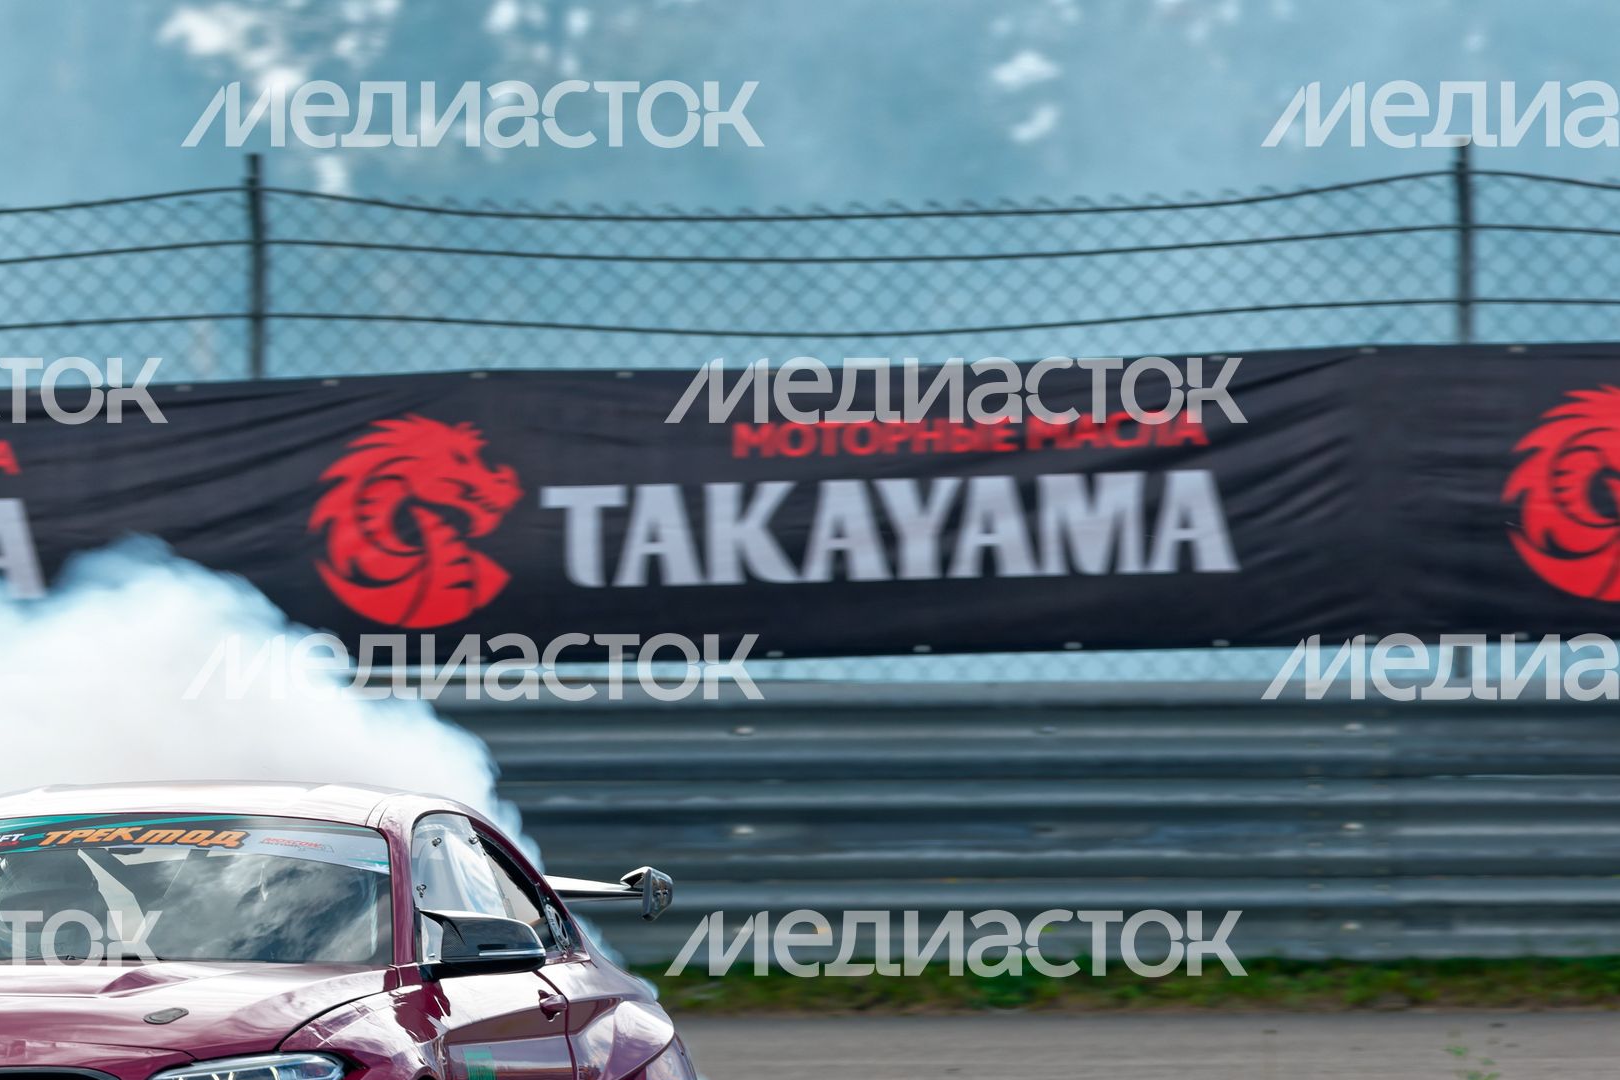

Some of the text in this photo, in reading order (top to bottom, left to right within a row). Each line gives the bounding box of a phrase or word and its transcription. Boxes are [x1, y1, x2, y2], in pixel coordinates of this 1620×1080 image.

[732, 409, 1210, 459] МОТОРНЫЕ МАСЛА
[539, 470, 1242, 588] TAKAYAMA
